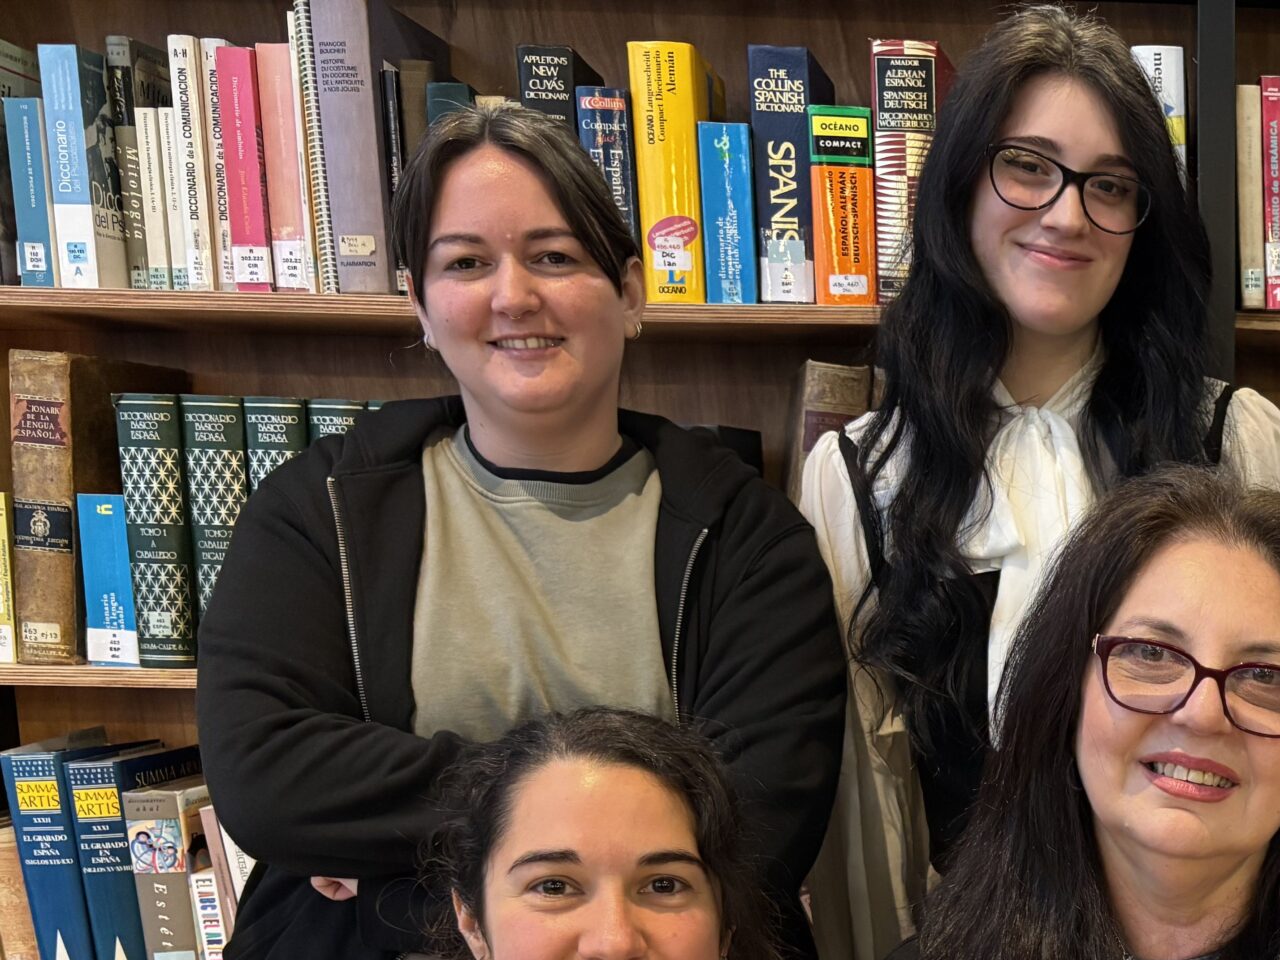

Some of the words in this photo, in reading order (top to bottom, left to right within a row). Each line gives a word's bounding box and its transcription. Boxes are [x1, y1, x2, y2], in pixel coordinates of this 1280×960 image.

[174, 49, 187, 58] A-H
[523, 55, 567, 65] APPLETON'S
[532, 65, 559, 77] NEW
[655, 50, 663, 101] Diccionario
[664, 51, 676, 95] Alemán
[768, 68, 787, 79] THE
[885, 69, 925, 79] ALEMAN
[529, 77, 565, 91] CUYÁS
[753, 79, 803, 91] COLLINS
[885, 77, 925, 88] ESPAÑOL
[525, 92, 569, 101] DICTIONARY
[754, 90, 804, 104] SPANISH
[883, 91, 927, 101] SPANISCH
[177, 67, 192, 140] COMUNICACION
[209, 69, 223, 140] COMUNICACION
[591, 97, 624, 108] Collins
[756, 102, 805, 113] DICTIONARY
[884, 100, 927, 109] DEUTSCH
[879, 111, 932, 121] DICCIONARIO
[582, 119, 627, 135] Compact
[655, 104, 667, 142] Compact
[820, 122, 859, 132] OCÉANO
[186, 141, 193, 149] la
[819, 139, 862, 149] COMPACT
[1269, 120, 1280, 178] CERÁMICA
[53, 119, 72, 193] Diccionario
[187, 150, 194, 160] de
[186, 161, 199, 221] DICCIONARIO
[216, 162, 228, 221] DICCIONARIO
[717, 228, 726, 279] diccionario
[658, 286, 686, 294] OCEANO
[26, 413, 37, 422] DE
[39, 414, 49, 422] LA
[120, 412, 170, 421] DICCIONARIO
[185, 413, 236, 423] DICCIONARIO
[21, 421, 55, 431] LENGUA
[131, 431, 160, 440] ESPASA
[195, 432, 226, 442] ESPASA
[140, 528, 161, 537] TOMO
[136, 550, 177, 560] CABALLERO
[16, 783, 58, 794] SUMMA
[19, 794, 60, 808] ARTIS
[73, 790, 118, 803] SUMMA
[76, 802, 121, 816] ARTIS
[34, 834, 68, 842] GRABADO
[33, 848, 60, 857] ESPAÑA
